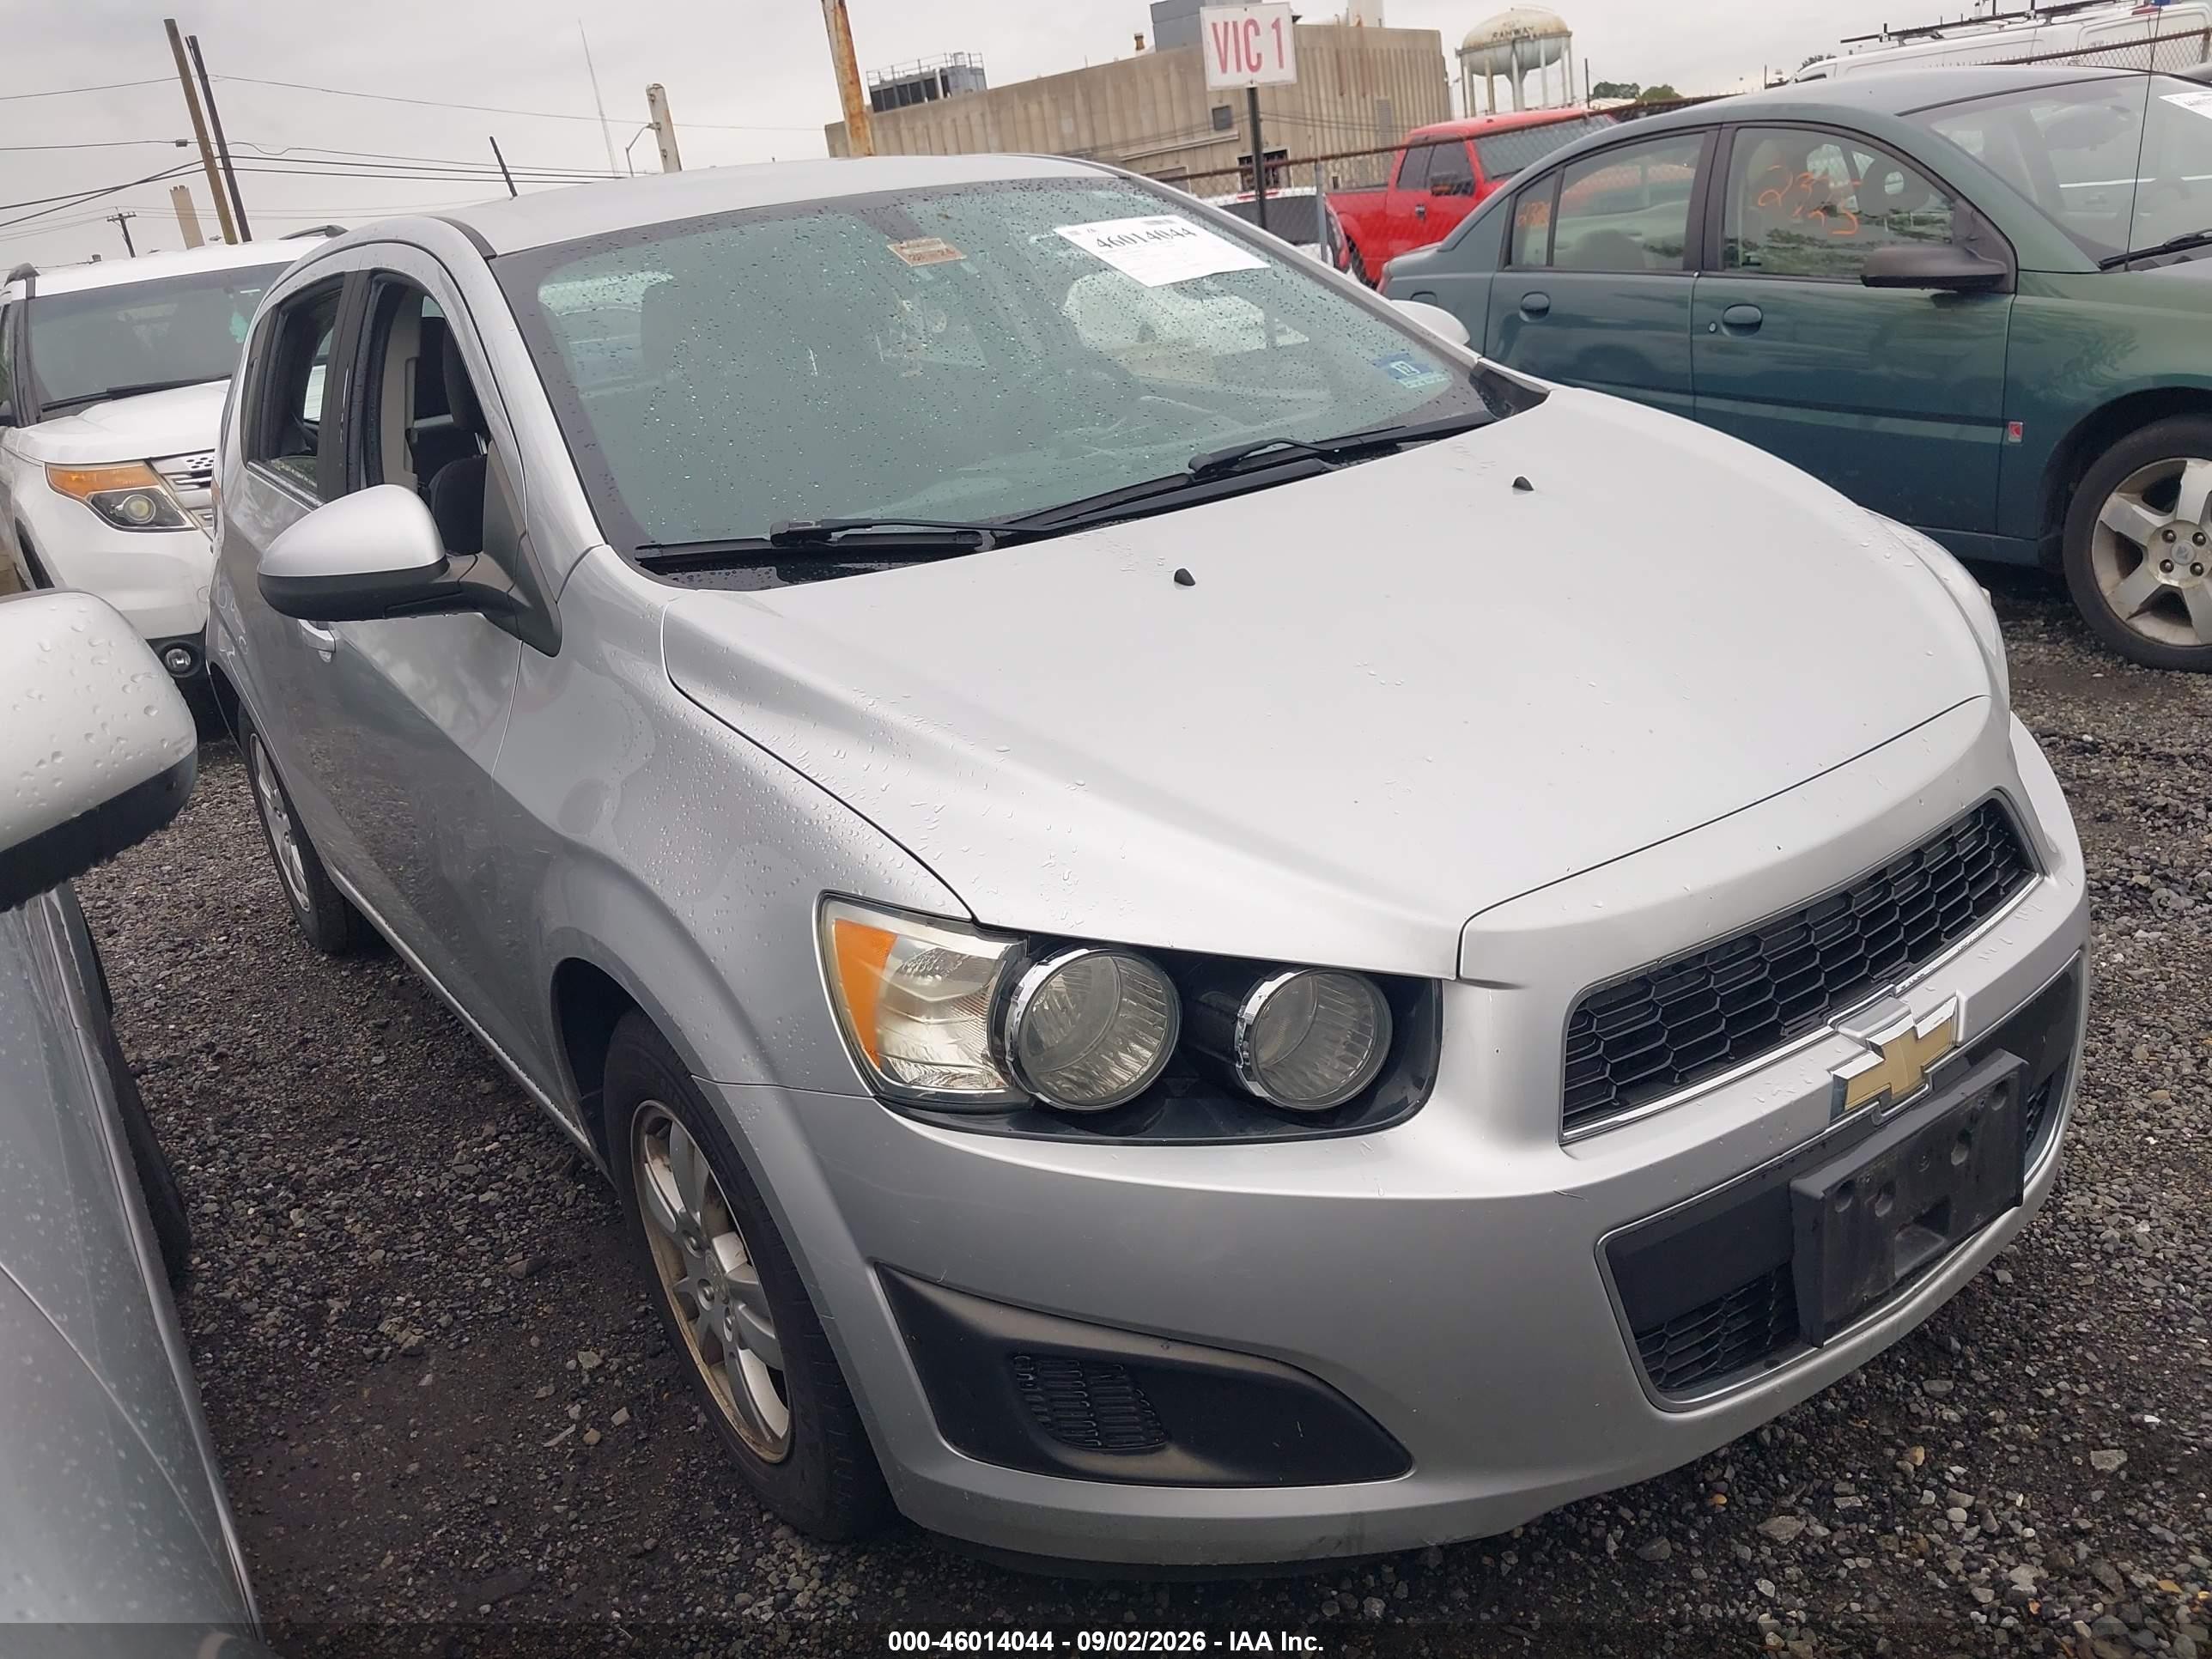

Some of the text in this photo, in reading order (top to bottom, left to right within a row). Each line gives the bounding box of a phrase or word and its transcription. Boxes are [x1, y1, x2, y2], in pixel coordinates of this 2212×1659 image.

[1212, 17, 1285, 74] VIC 1
[1096, 227, 1198, 249] 46014044
